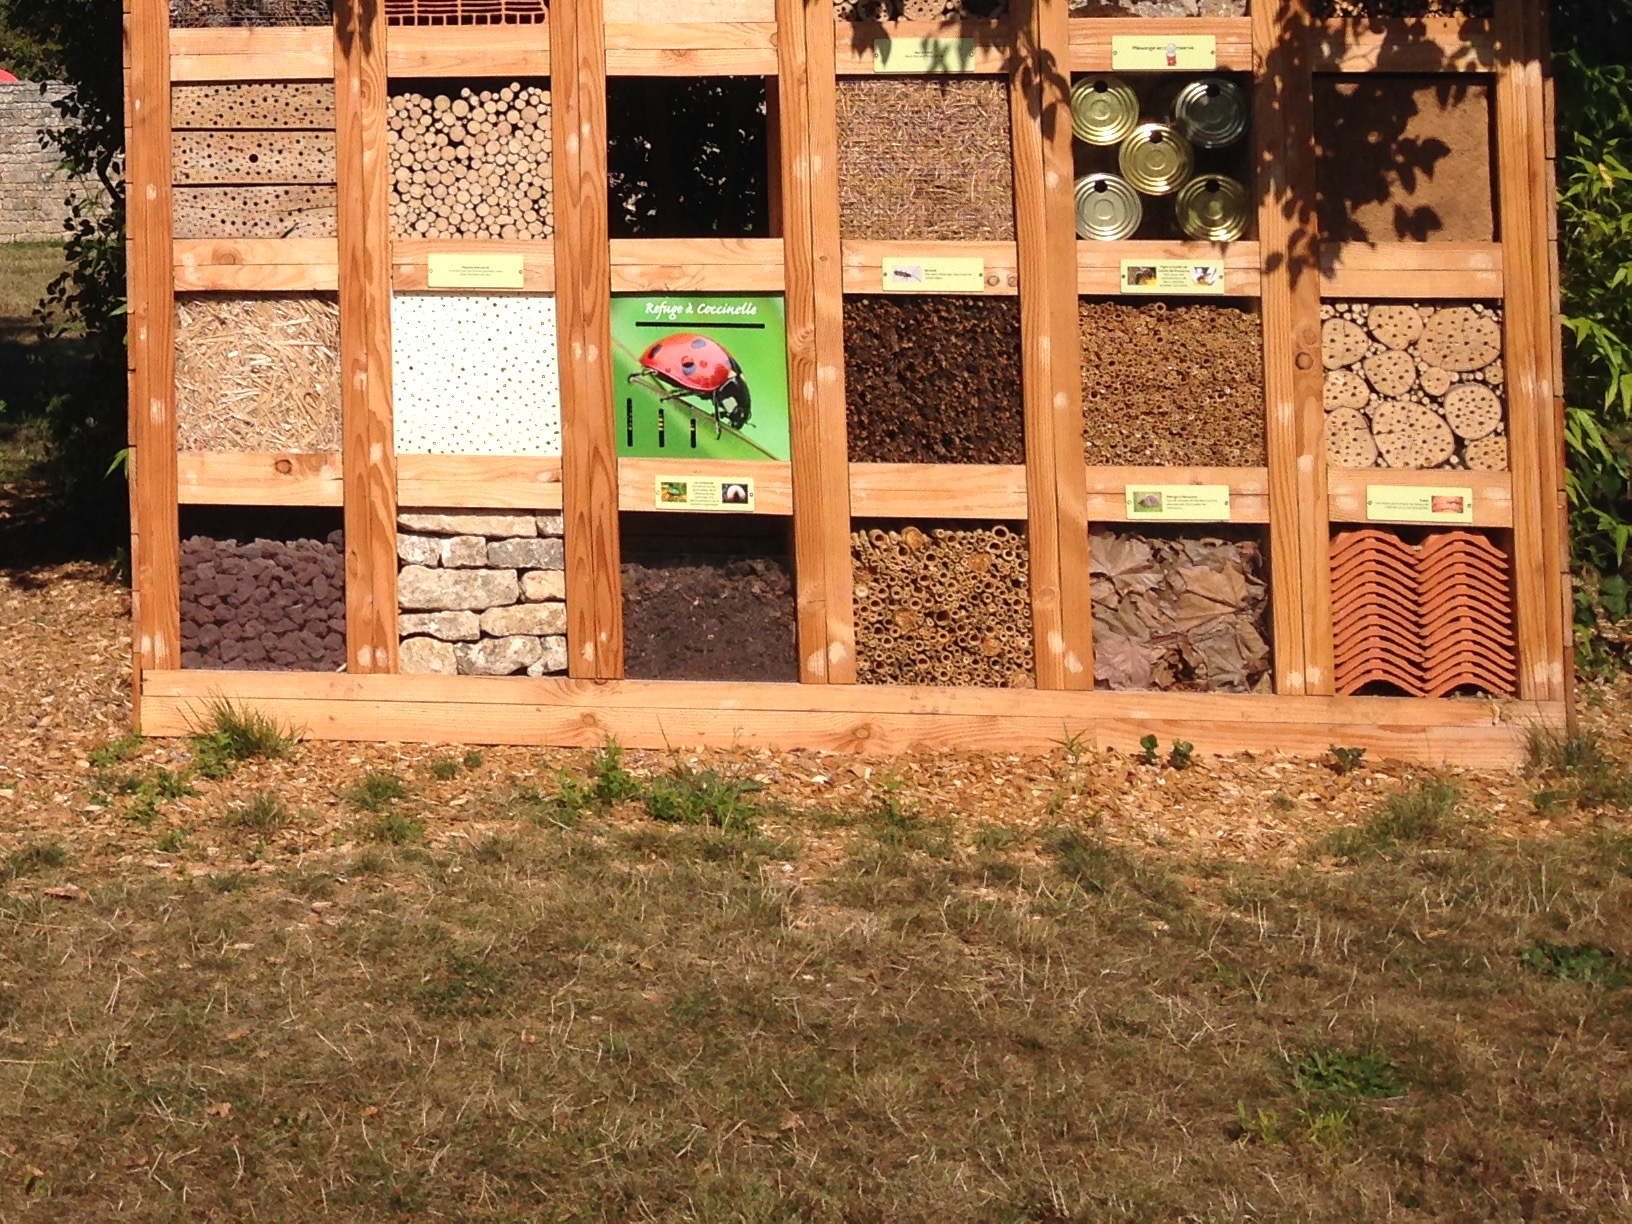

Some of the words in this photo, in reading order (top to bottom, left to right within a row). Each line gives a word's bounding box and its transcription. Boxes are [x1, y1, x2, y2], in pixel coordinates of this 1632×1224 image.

[645, 301, 684, 320] Refuge
[685, 303, 694, 314] à
[697, 302, 757, 315] Coccinelle
